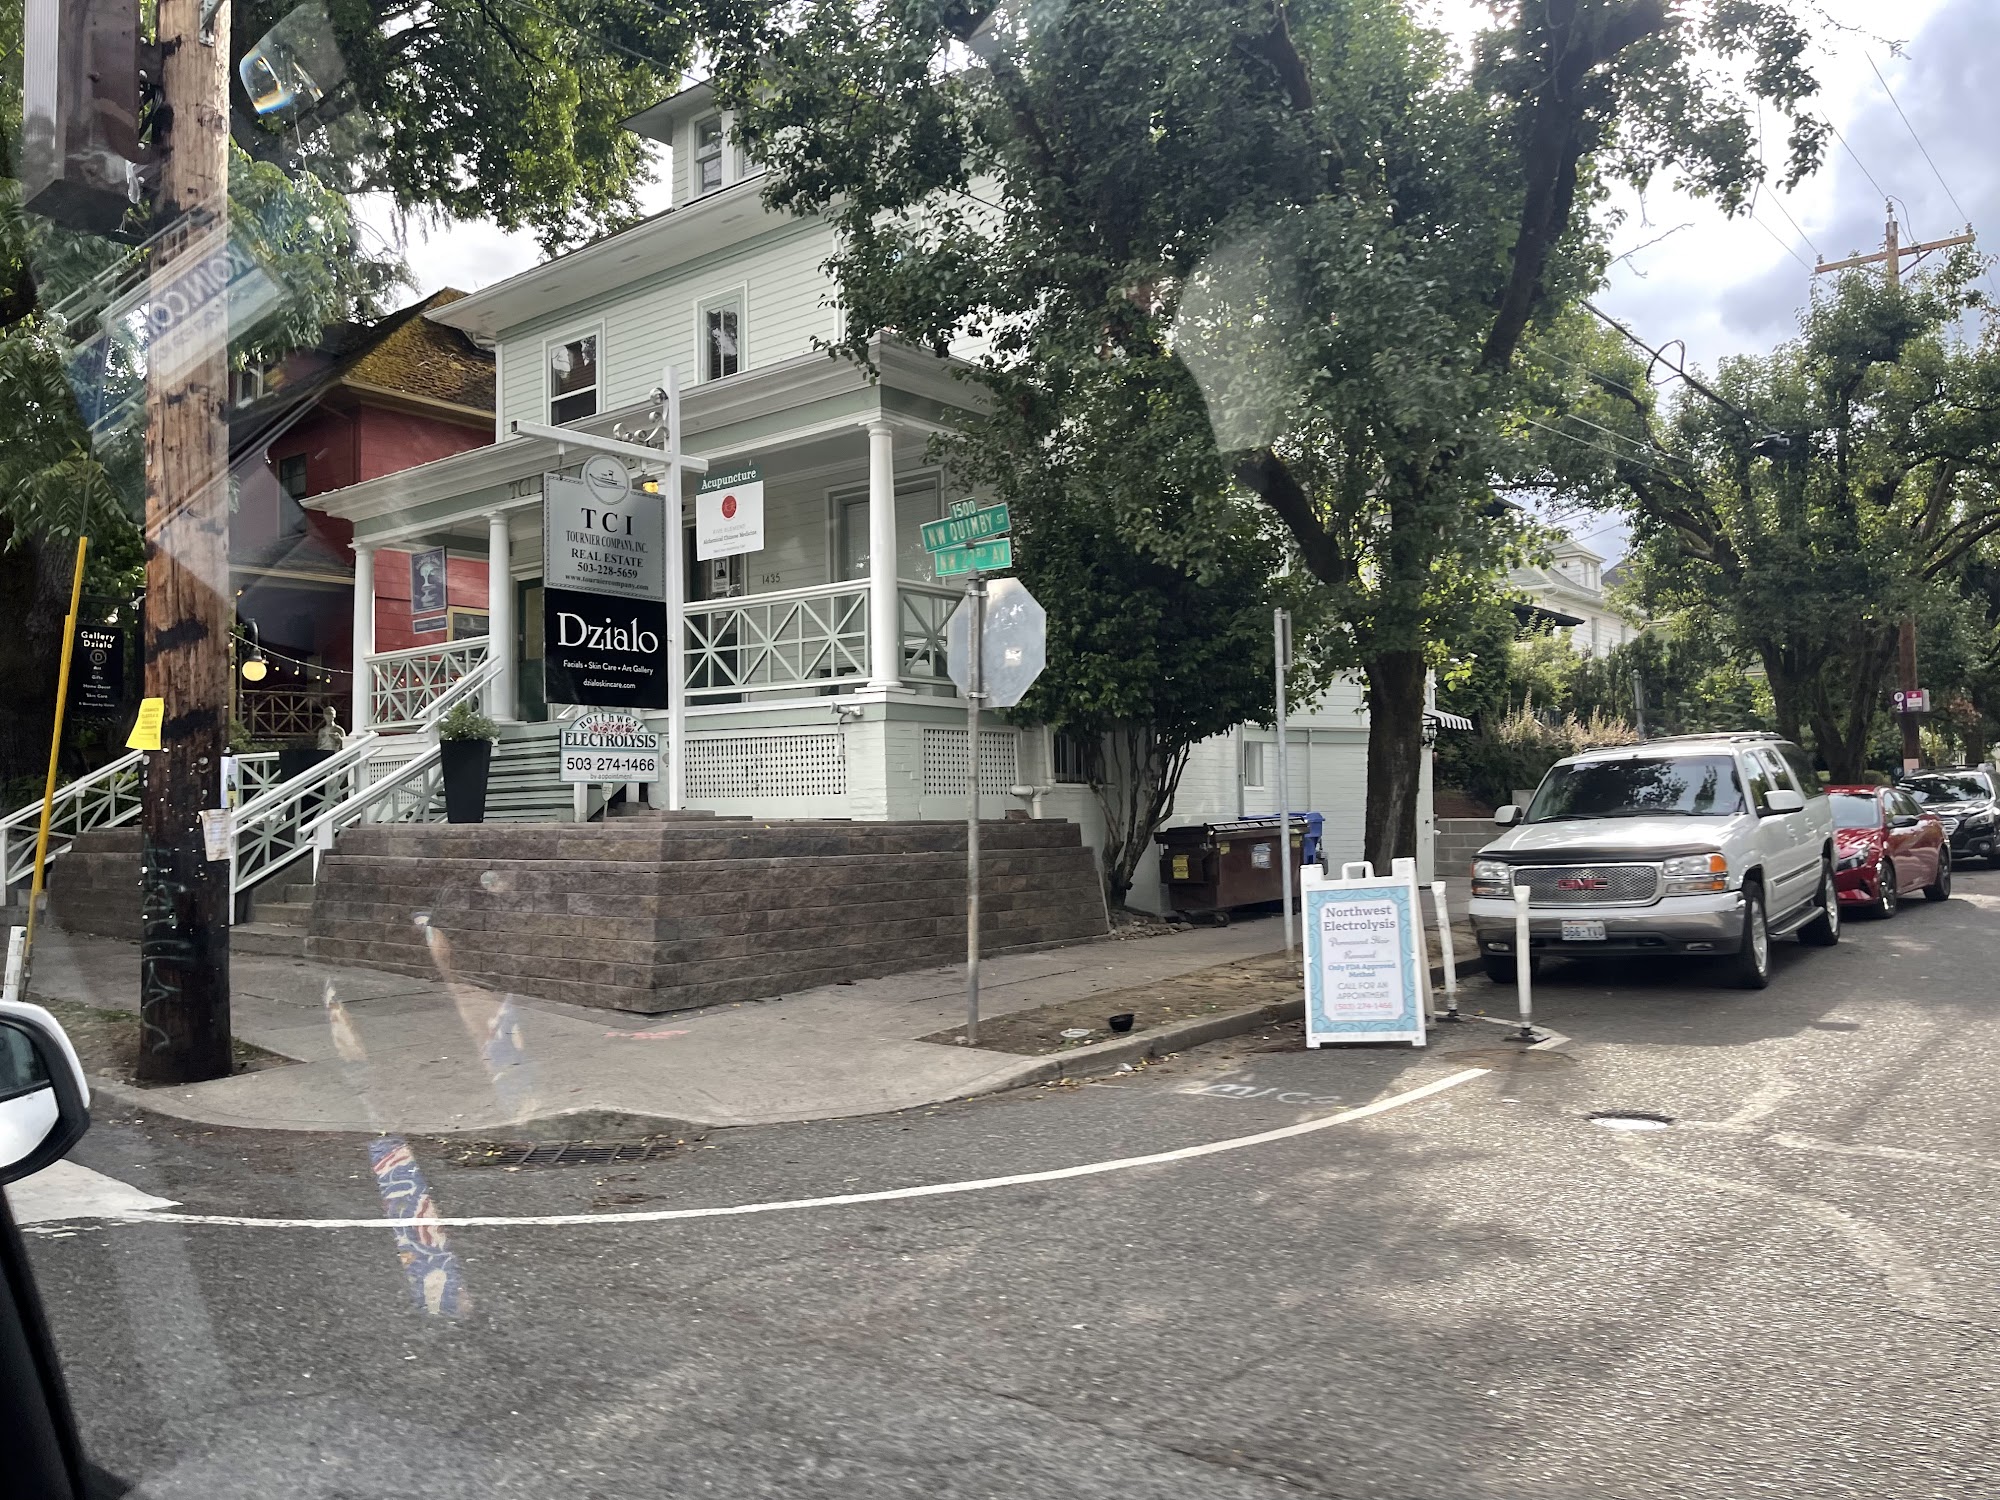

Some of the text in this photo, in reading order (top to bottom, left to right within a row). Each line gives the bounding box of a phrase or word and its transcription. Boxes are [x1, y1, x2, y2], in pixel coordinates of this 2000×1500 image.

[701, 469, 757, 490] Acupuncture
[951, 500, 976, 519] 1500
[580, 507, 634, 535] TCI
[927, 512, 1005, 548] NW QUIMBY ST
[566, 530, 601, 547] TOURNIER
[635, 540, 648, 553] INC.
[571, 547, 643, 568] REAL ESTATE
[940, 551, 956, 571] NW
[992, 545, 1006, 564] AV
[577, 561, 638, 579] 503-228-5659
[565, 574, 649, 592] www.tourniercompany.com
[762, 573, 781, 585] 1435
[81, 631, 115, 642] Gallery
[557, 612, 659, 654] Dzialo
[83, 640, 112, 648] Dzialo
[563, 659, 654, 676] Facials Skin Care Art Gallery
[583, 678, 636, 690] dzialoskincare.com
[578, 713, 644, 732] northwest
[564, 732, 657, 748] ELECTROLYSIS
[566, 757, 655, 771] 503 274-1466
[1558, 877, 1608, 891] GMC
[1325, 905, 1392, 918] Northwest
[1323, 919, 1396, 932] Electrolysis
[1328, 964, 1345, 972] Only
[1337, 981, 1389, 990] CALL FOR AN
[1336, 991, 1390, 1000] APPOINTMENT
